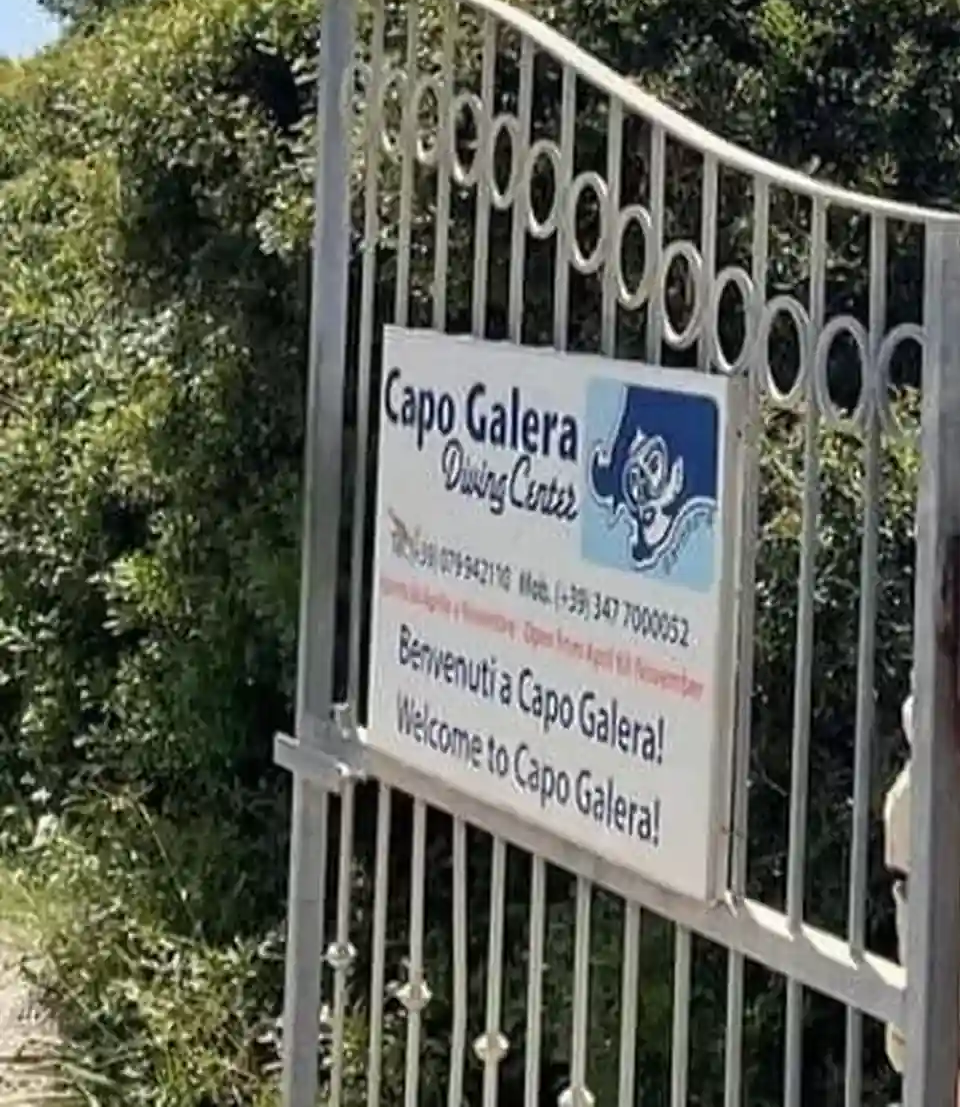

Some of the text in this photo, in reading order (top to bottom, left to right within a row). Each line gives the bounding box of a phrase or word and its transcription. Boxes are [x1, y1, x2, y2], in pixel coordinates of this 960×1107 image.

[384, 367, 578, 463] Capo Galera
[441, 438, 579, 521] Diving Center
[592, 591, 621, 626] 347
[622, 599, 691, 647] 7000052
[398, 623, 666, 766] Benvenuti a Capo Galera!
[397, 692, 661, 847] Welcome to Capo Galera!
